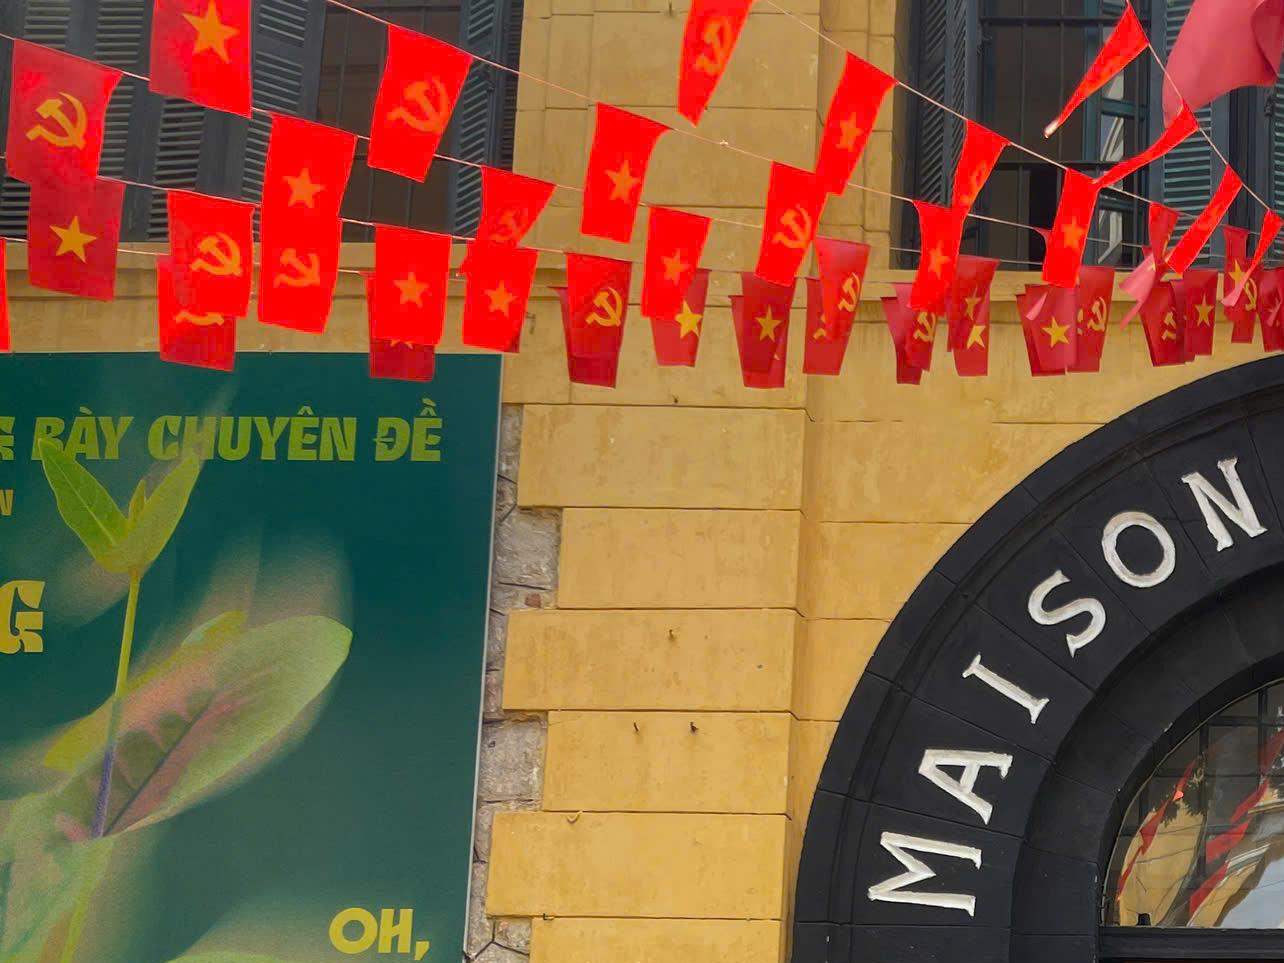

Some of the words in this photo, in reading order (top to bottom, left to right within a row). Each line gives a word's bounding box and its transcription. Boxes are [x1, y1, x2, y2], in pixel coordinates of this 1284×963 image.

[31, 406, 134, 461] BÀY
[147, 405, 357, 462] CHUYÊN
[373, 398, 443, 462] ĐỀ
[867, 456, 1268, 918] MAISON
[329, 907, 430, 961] OH,
